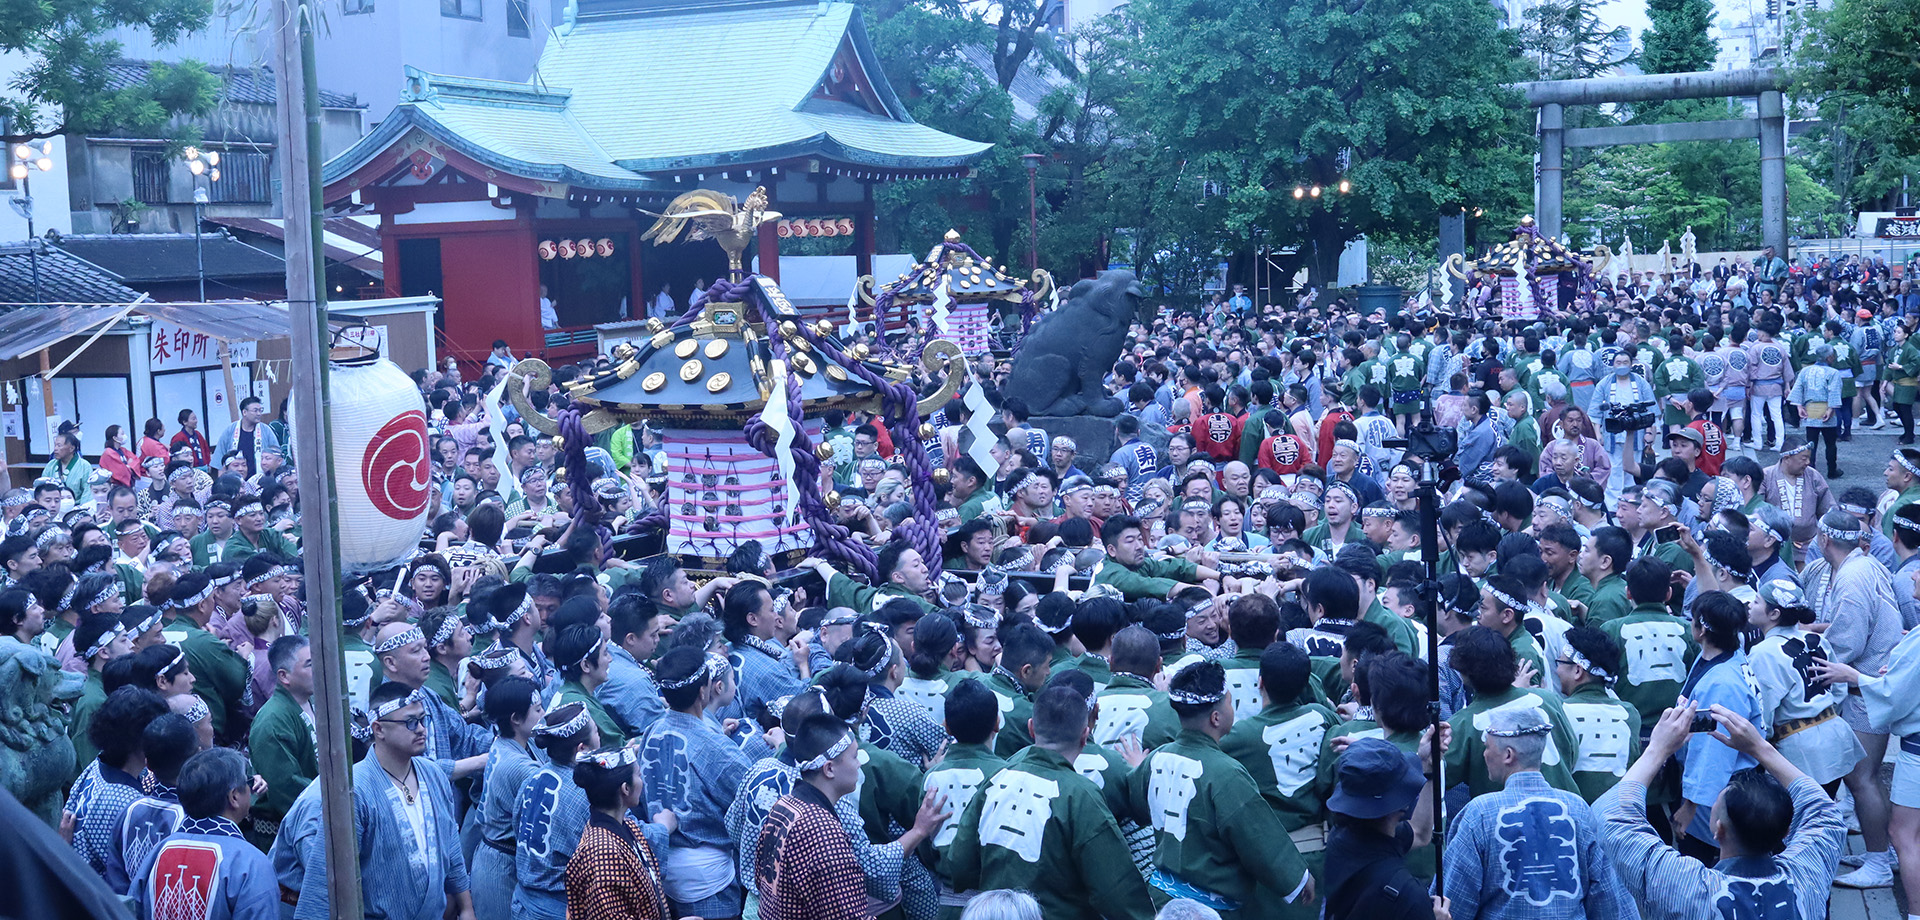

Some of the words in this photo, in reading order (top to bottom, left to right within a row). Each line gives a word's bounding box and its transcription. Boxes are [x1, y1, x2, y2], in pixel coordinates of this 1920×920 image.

[152, 327, 210, 365] 朱印所
[1621, 621, 1688, 687] 西
[978, 767, 1060, 863] 西
[1147, 751, 1204, 842] 西
